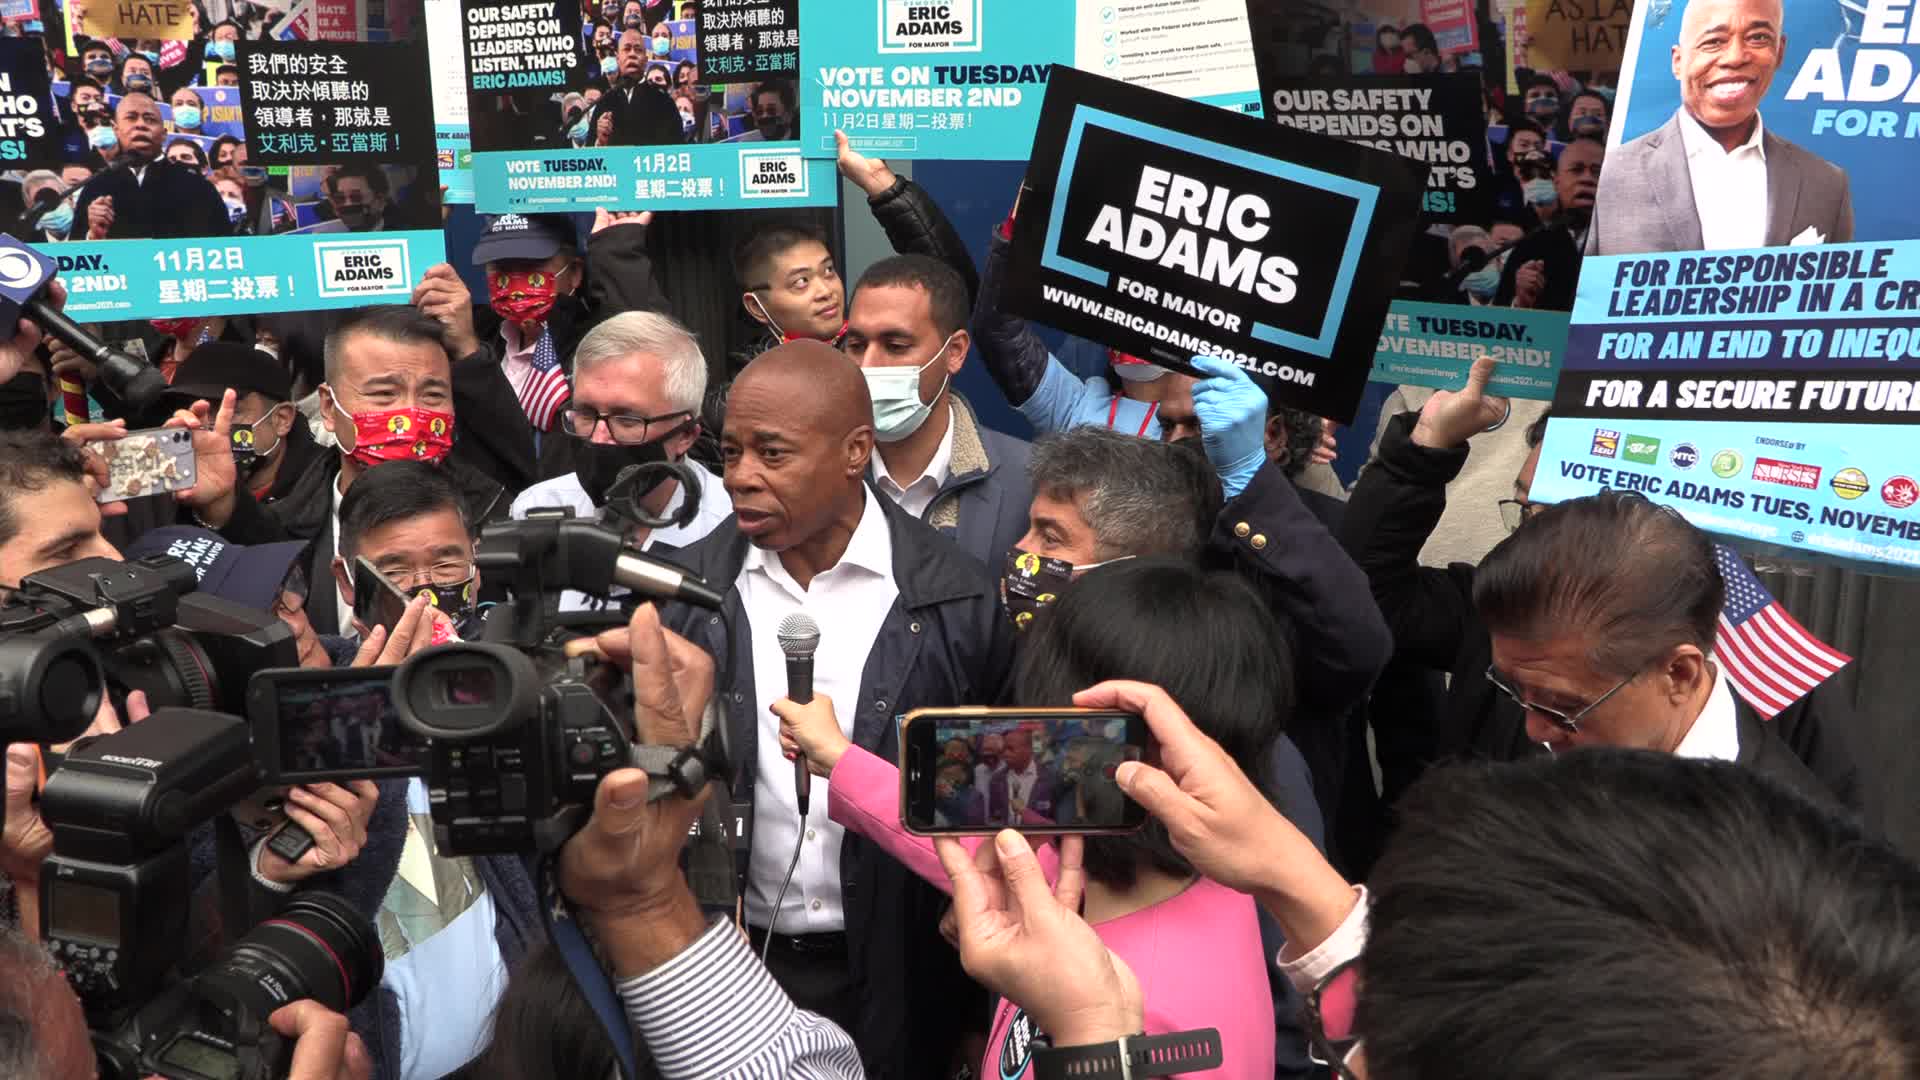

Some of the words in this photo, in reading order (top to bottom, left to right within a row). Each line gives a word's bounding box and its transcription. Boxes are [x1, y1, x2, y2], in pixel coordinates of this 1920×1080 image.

[467, 7, 500, 23] OUR
[501, 2, 555, 21] SAFETY
[703, 7, 784, 30] 取決於傾聽的
[908, 6, 951, 20] ERIC
[469, 22, 536, 40] DEPENDS
[537, 19, 560, 35] ON
[896, 20, 963, 36] ADAMS
[470, 38, 534, 56] LEADERS
[534, 35, 574, 53] WHO
[248, 53, 348, 75] 我們的安全
[471, 56, 524, 73] LISTEN.
[525, 52, 577, 71] THAT'S
[472, 73, 507, 90] ERIC
[507, 70, 566, 88] ADAMS!
[819, 66, 884, 87] VOTE
[891, 65, 930, 86] ON
[934, 64, 1050, 85] TUESDAY
[250, 80, 369, 101] 取決於傾聽的
[822, 88, 964, 109] NOVEMBER
[967, 87, 1022, 108] 2ND
[1273, 89, 1331, 112] OUR
[1332, 88, 1433, 111] SAFETY
[1400, 114, 1444, 137] ON
[1812, 109, 1899, 138] FOR
[506, 160, 541, 174] VOTE
[544, 157, 608, 173] TUESDAY,
[633, 152, 692, 174] 11月2日
[759, 161, 788, 173] ERIC
[508, 175, 583, 191] NOVEMBER
[584, 174, 617, 188] 2ND!
[752, 173, 796, 185] ADAMS
[1134, 164, 1271, 243] ERIC
[1422, 191, 1456, 213] S!
[55, 254, 109, 273] DAY,
[152, 246, 244, 273] 11月2日
[343, 254, 381, 268] ERIC
[1085, 204, 1299, 304] ADAMS
[334, 267, 393, 282] ADAMS
[1614, 260, 1671, 288] FOR
[1676, 248, 1894, 284] RESPONSIBLE
[1116, 276, 1159, 305] FOR
[1162, 292, 1242, 334] MAYOR
[1607, 283, 1792, 317] LEADERSHIP
[1797, 282, 1835, 312] IN
[1840, 281, 1863, 311] A
[1043, 285, 1316, 388] WWW.ERICADAMS2021.COM
[1386, 312, 1410, 332] TE
[1416, 316, 1534, 344] TUESDAY,
[1376, 335, 1487, 361] OVEMBER
[1491, 344, 1553, 369] 2ND!
[1598, 332, 1654, 360] FOR
[1658, 331, 1704, 360] AN
[1708, 329, 1772, 359] END
[1782, 329, 1824, 359] TO
[1585, 379, 1644, 408] FOR
[1646, 379, 1668, 408] A
[1676, 379, 1797, 410] SECURE
[1755, 436, 1795, 450] ENDORSED
[1795, 442, 1807, 450] BY
[1560, 461, 1612, 485] VOTE
[1614, 470, 1662, 494] ERIC
[1665, 479, 1745, 509] ADAMS
[1751, 493, 1815, 524] TUES,
[167, 538, 193, 559] RIC
